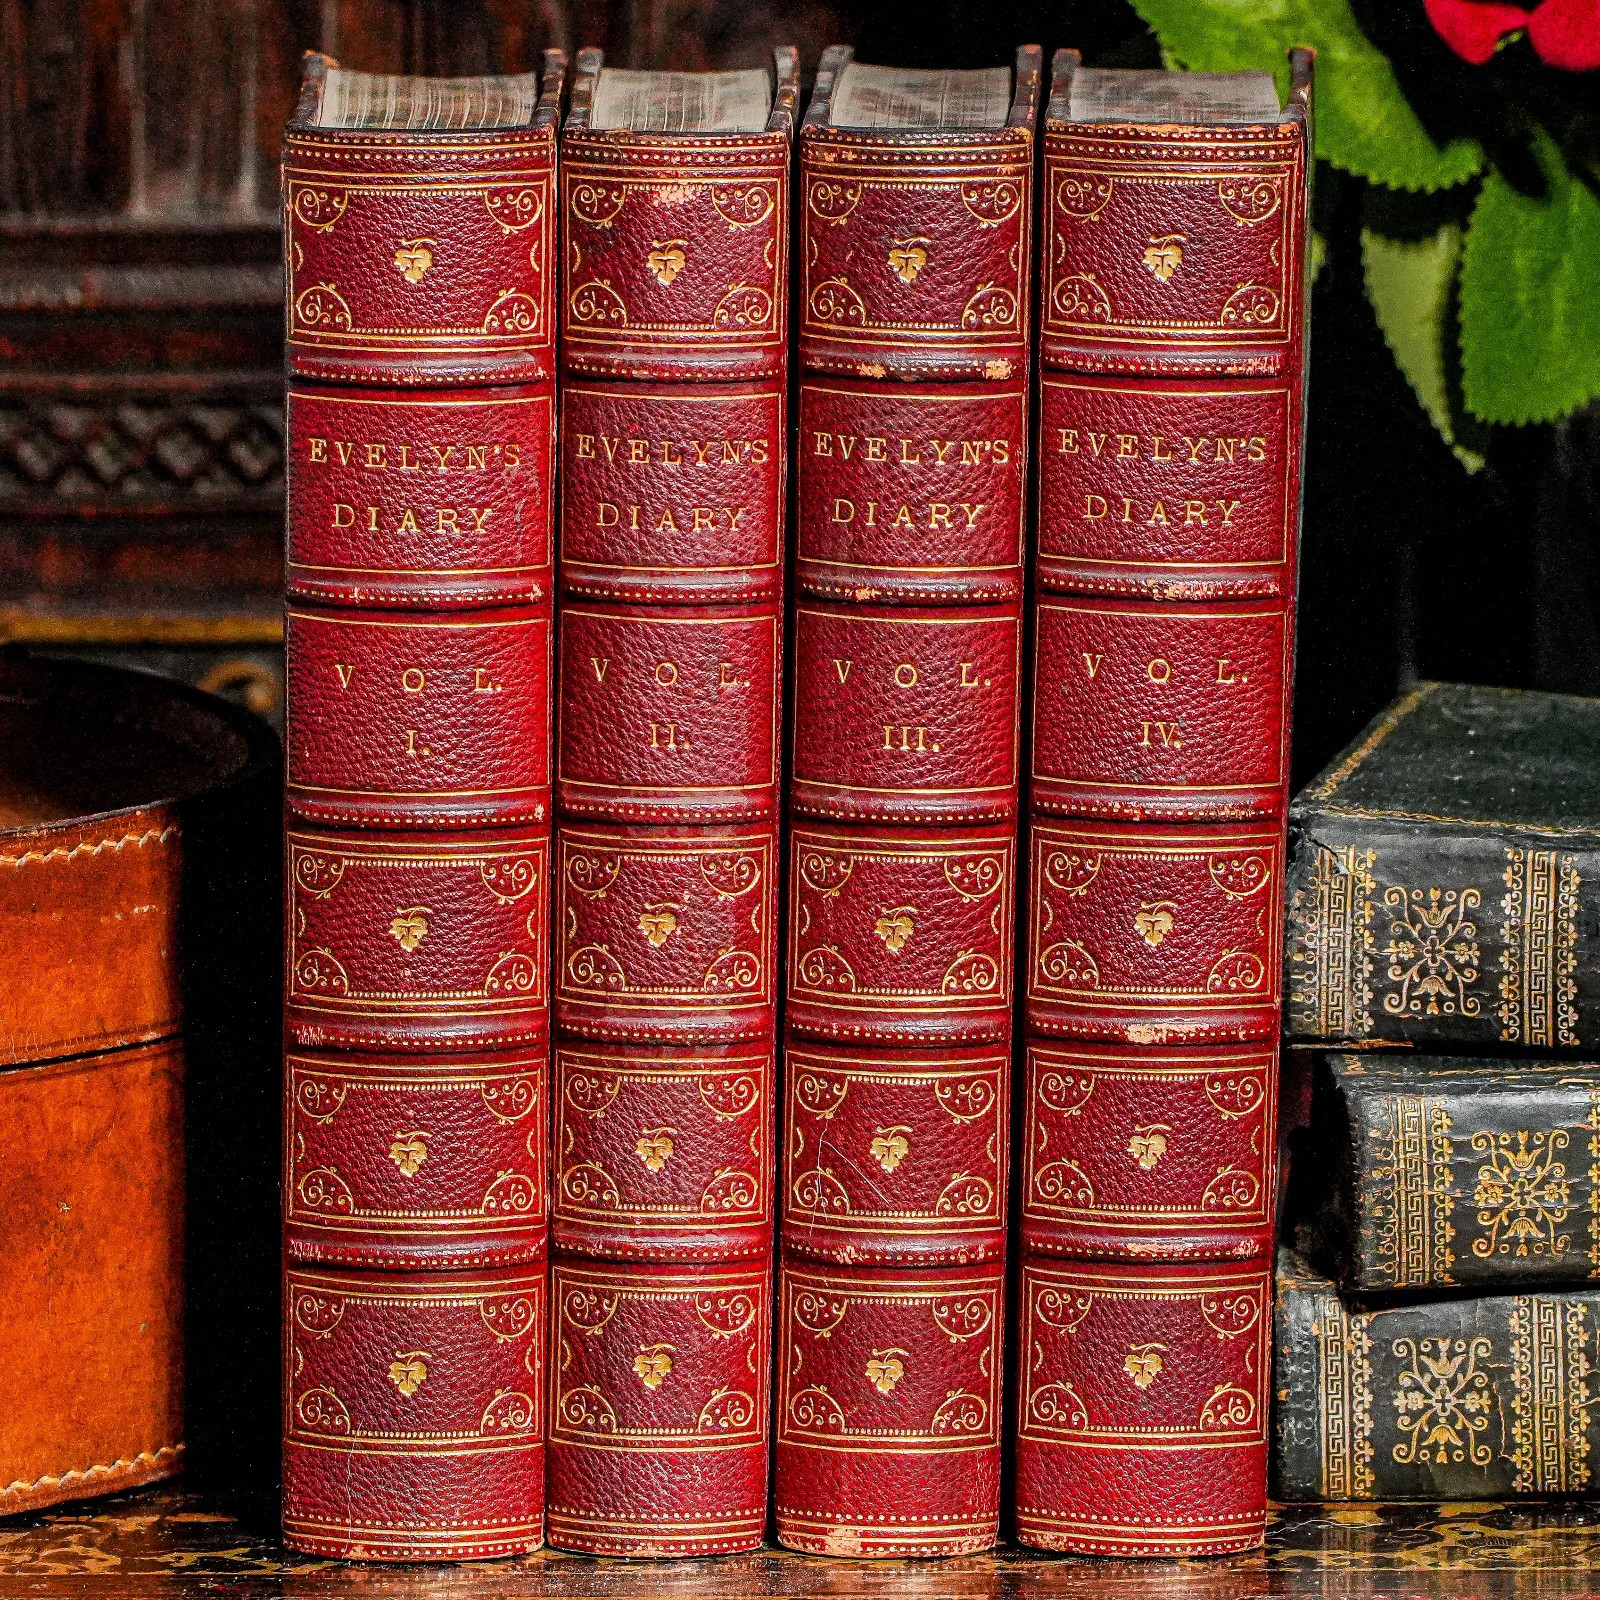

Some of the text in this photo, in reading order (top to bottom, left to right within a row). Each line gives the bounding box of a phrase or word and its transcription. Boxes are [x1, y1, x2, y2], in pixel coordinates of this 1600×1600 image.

[309, 437, 520, 470] EVELYN'S
[575, 433, 769, 466] EVELYN'S
[813, 431, 1010, 465] EVELYN'S
[1058, 428, 1267, 462] EVELYN'S
[331, 504, 493, 534] DIARY
[596, 502, 746, 533] DIARY
[831, 498, 984, 529] DIARY
[1083, 494, 1240, 526] DIARY
[405, 730, 431, 755] I.
[650, 723, 690, 749] II.
[882, 726, 940, 752] III.
[1140, 721, 1182, 748] IV.
